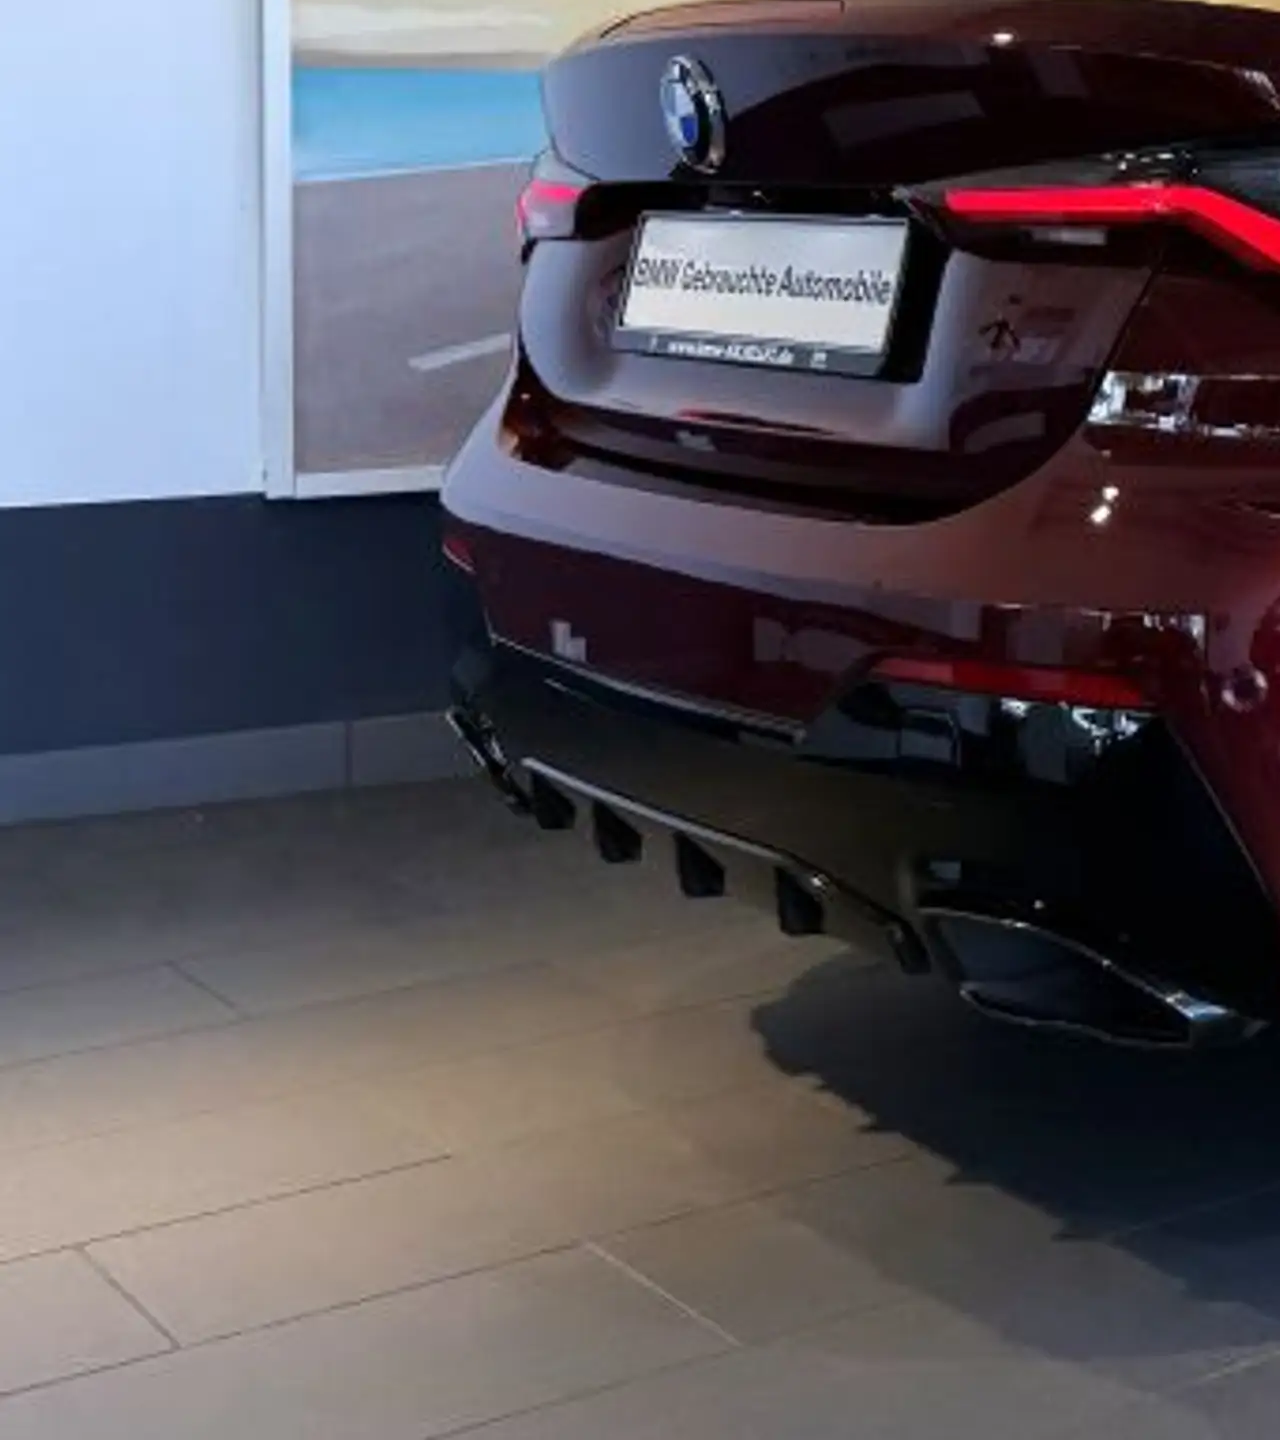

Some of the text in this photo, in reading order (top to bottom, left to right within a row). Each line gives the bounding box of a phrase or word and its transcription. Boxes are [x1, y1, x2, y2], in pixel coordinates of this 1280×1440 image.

[633, 258, 890, 305] BMW Gebrauchte Automobile
